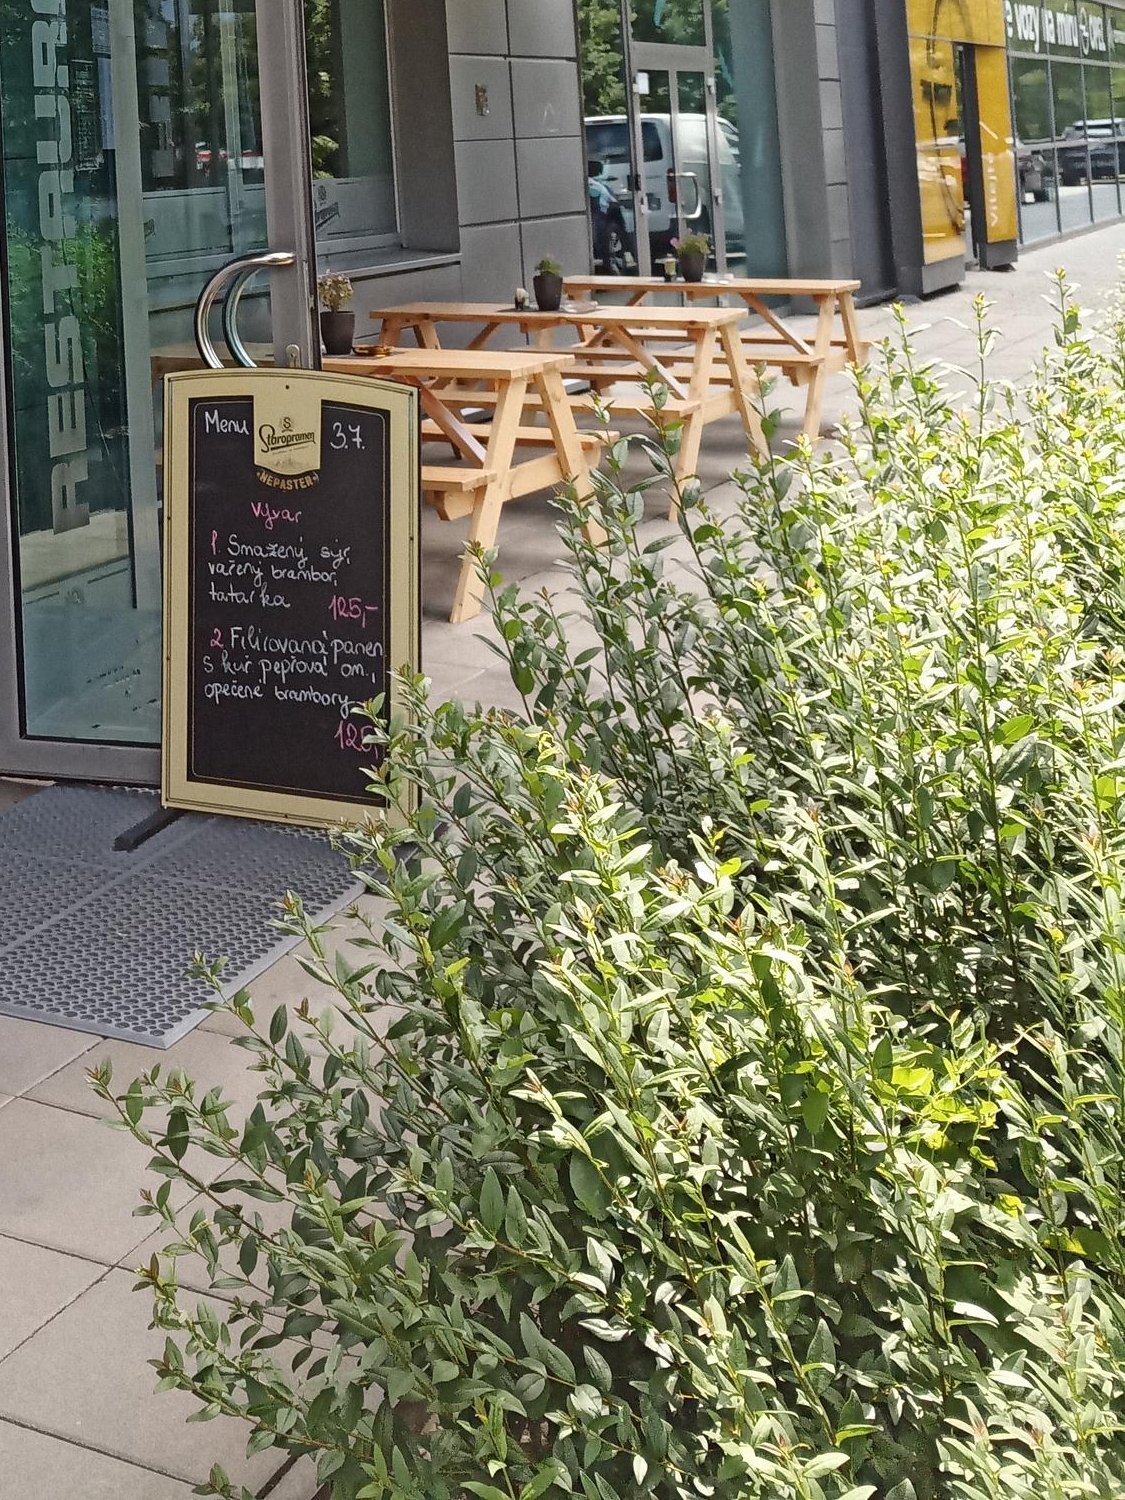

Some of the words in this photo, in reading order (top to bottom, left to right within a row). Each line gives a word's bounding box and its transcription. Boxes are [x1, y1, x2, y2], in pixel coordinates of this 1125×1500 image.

[204, 409, 250, 436] Menu
[258, 423, 317, 454] Staropramen
[227, 533, 309, 570] Smažený
[207, 559, 264, 588] vařený
